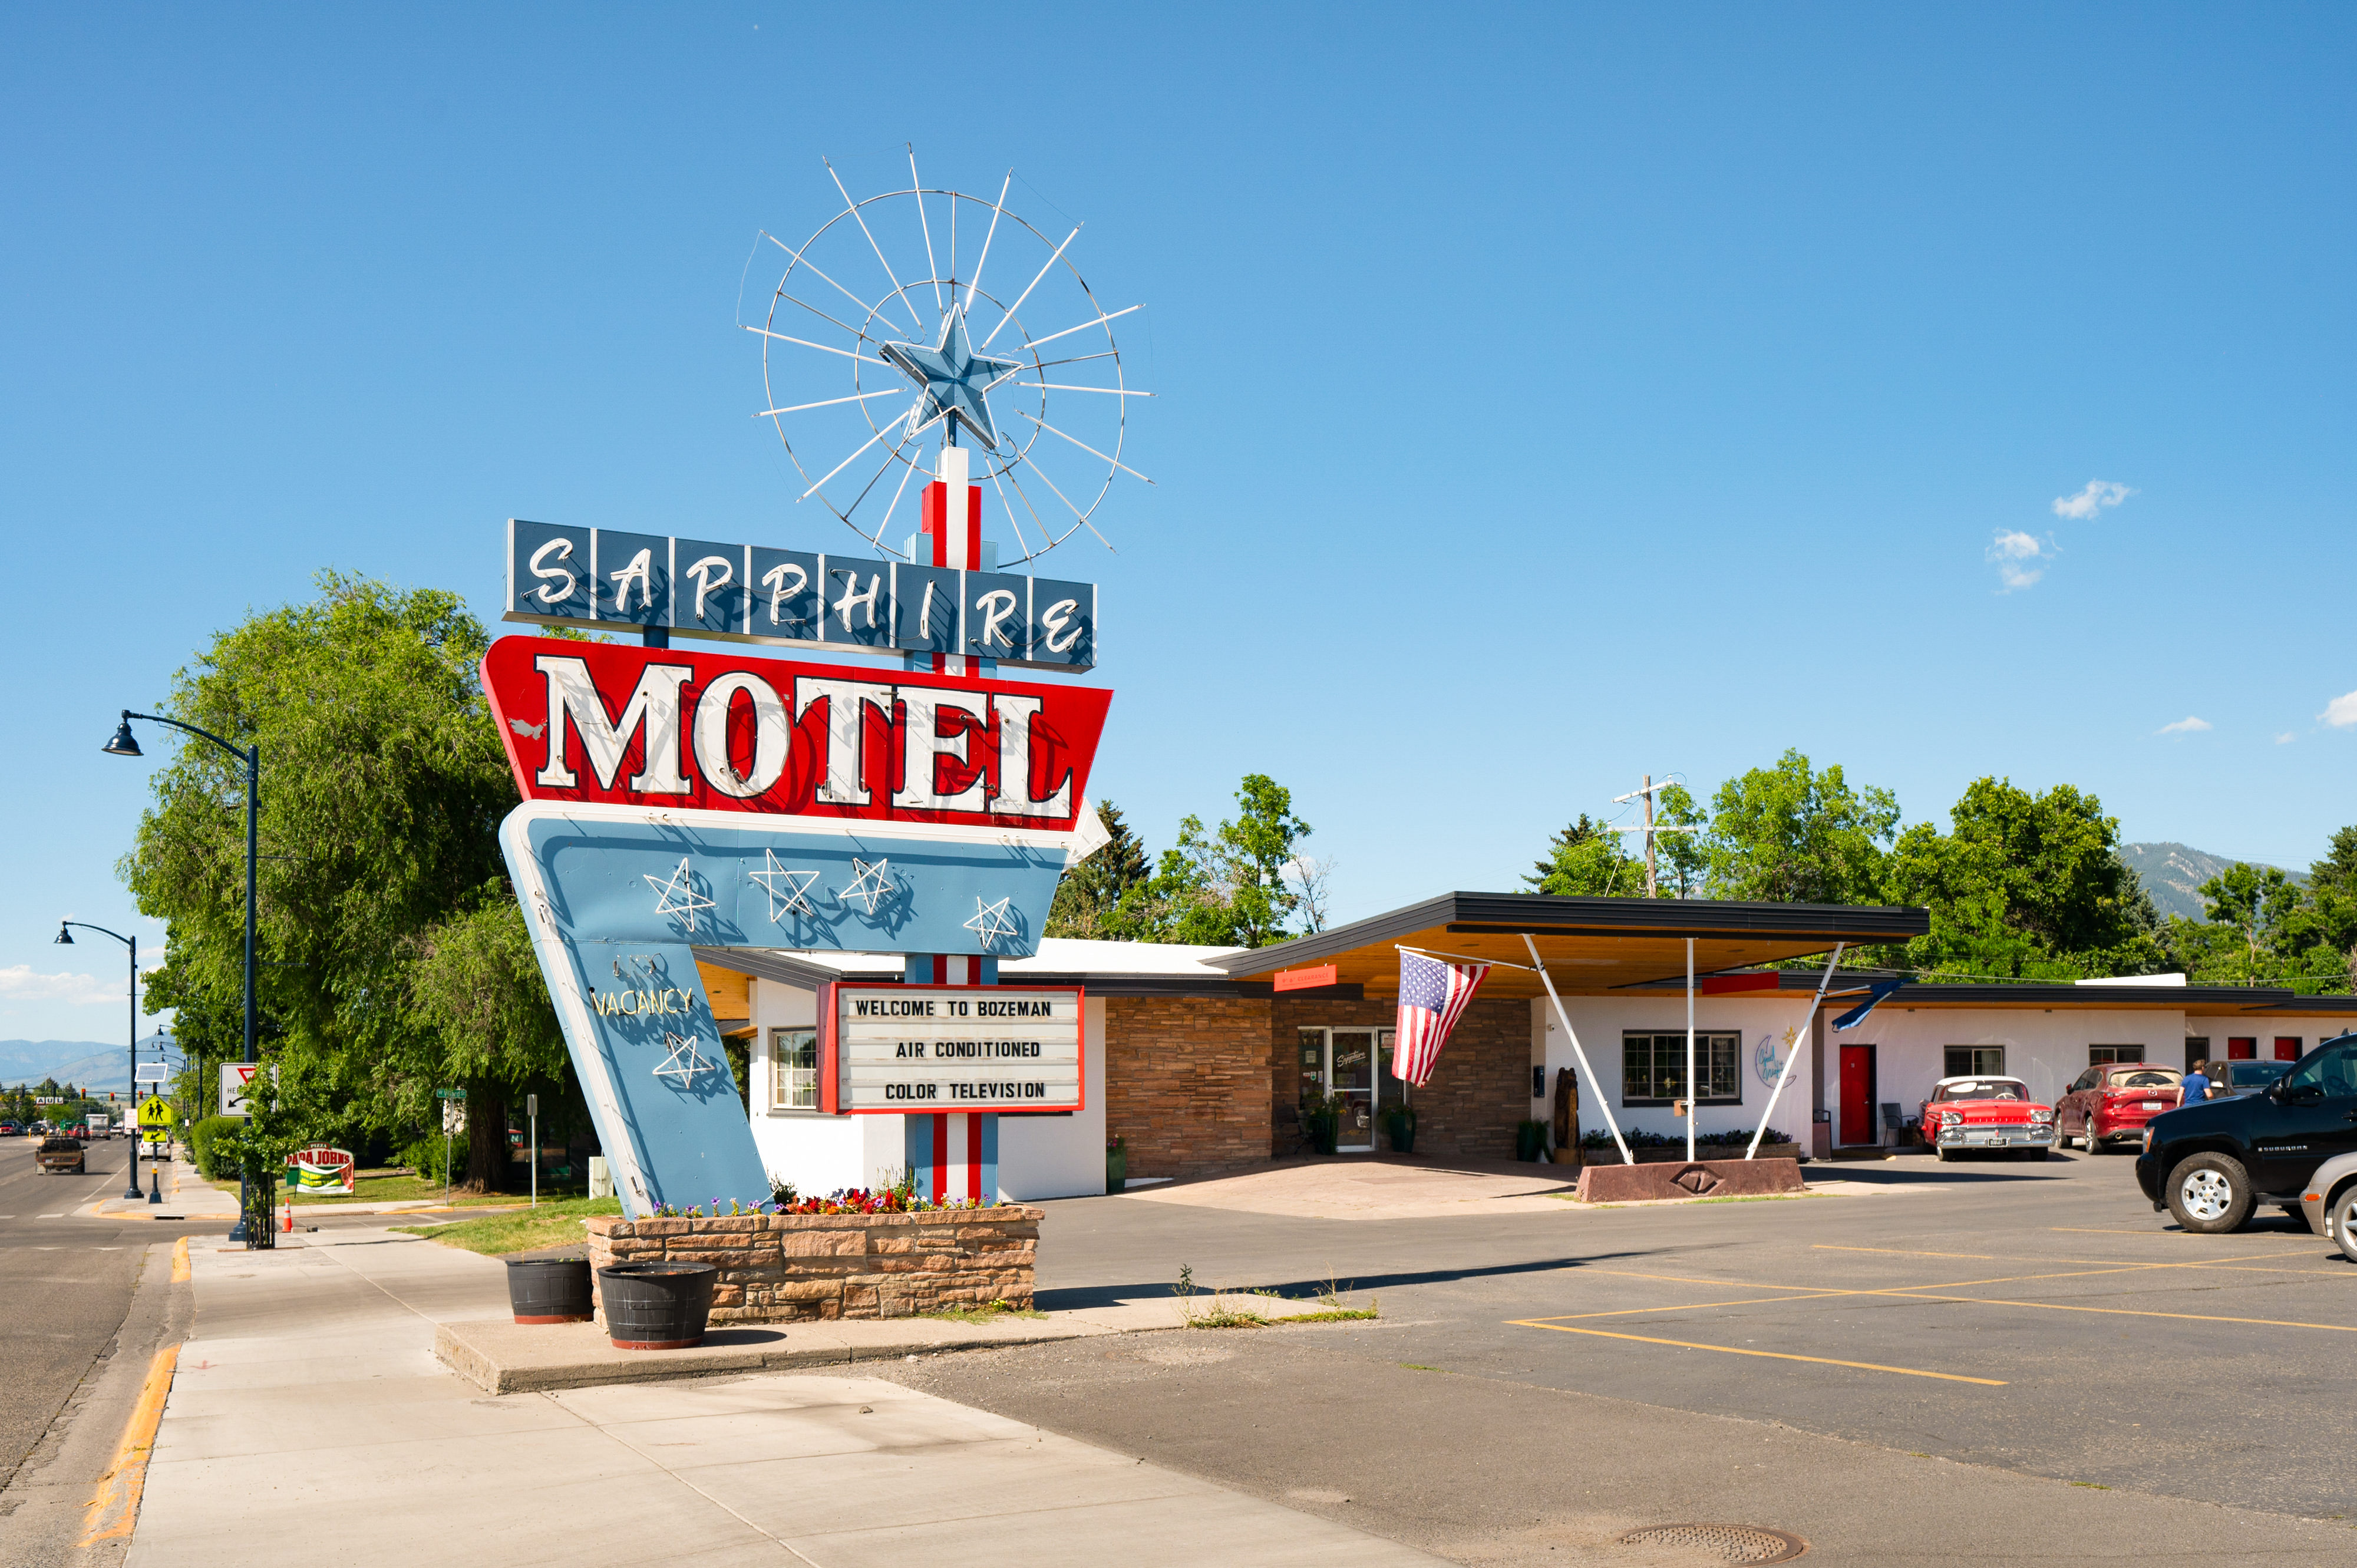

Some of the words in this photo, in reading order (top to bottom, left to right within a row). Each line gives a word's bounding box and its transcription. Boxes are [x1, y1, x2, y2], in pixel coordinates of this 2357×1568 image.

[521, 537, 1083, 653] SAPPHIRE
[533, 653, 1074, 818] MOTEL
[1298, 972, 1329, 982] CLEARANCE
[592, 987, 692, 1016] VACANCY
[856, 1000, 935, 1016] WELCOME
[948, 1001, 968, 1016] TO
[978, 1001, 1051, 1016] BOZEMAN
[896, 1042, 925, 1058] AIR
[936, 1041, 1041, 1057] CONDITIONED
[886, 1084, 936, 1100] COLOR
[949, 1082, 1045, 1099] TELEVISION
[287, 1151, 313, 1165] PAPA
